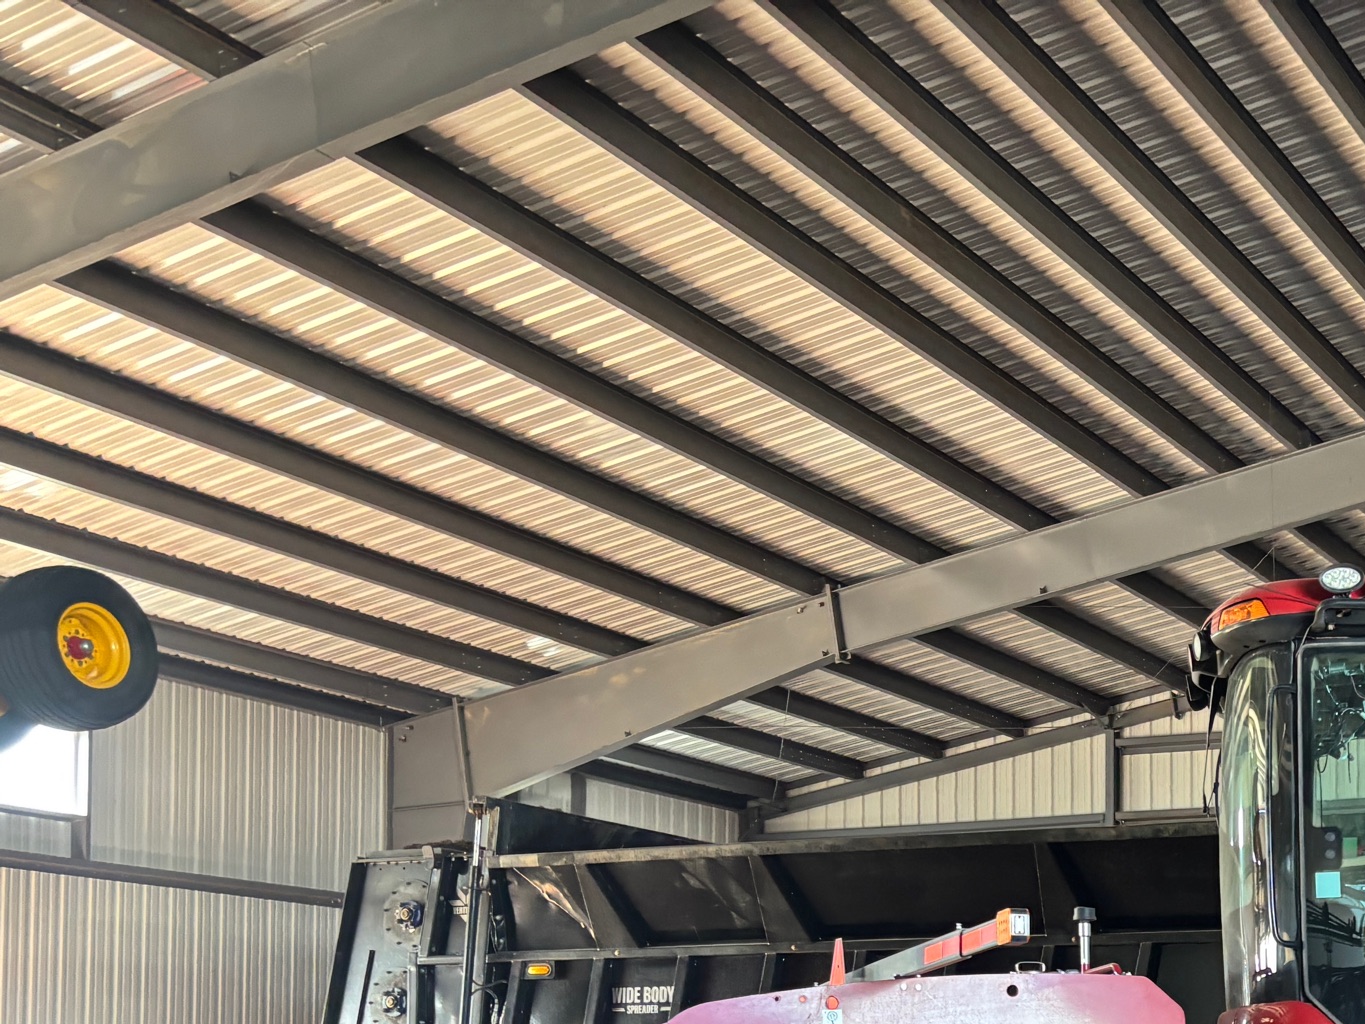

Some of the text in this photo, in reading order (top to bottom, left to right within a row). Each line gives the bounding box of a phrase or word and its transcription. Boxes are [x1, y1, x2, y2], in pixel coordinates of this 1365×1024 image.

[612, 985, 675, 1004] WIDE BODY
[626, 1005, 659, 1014] SPREADER
